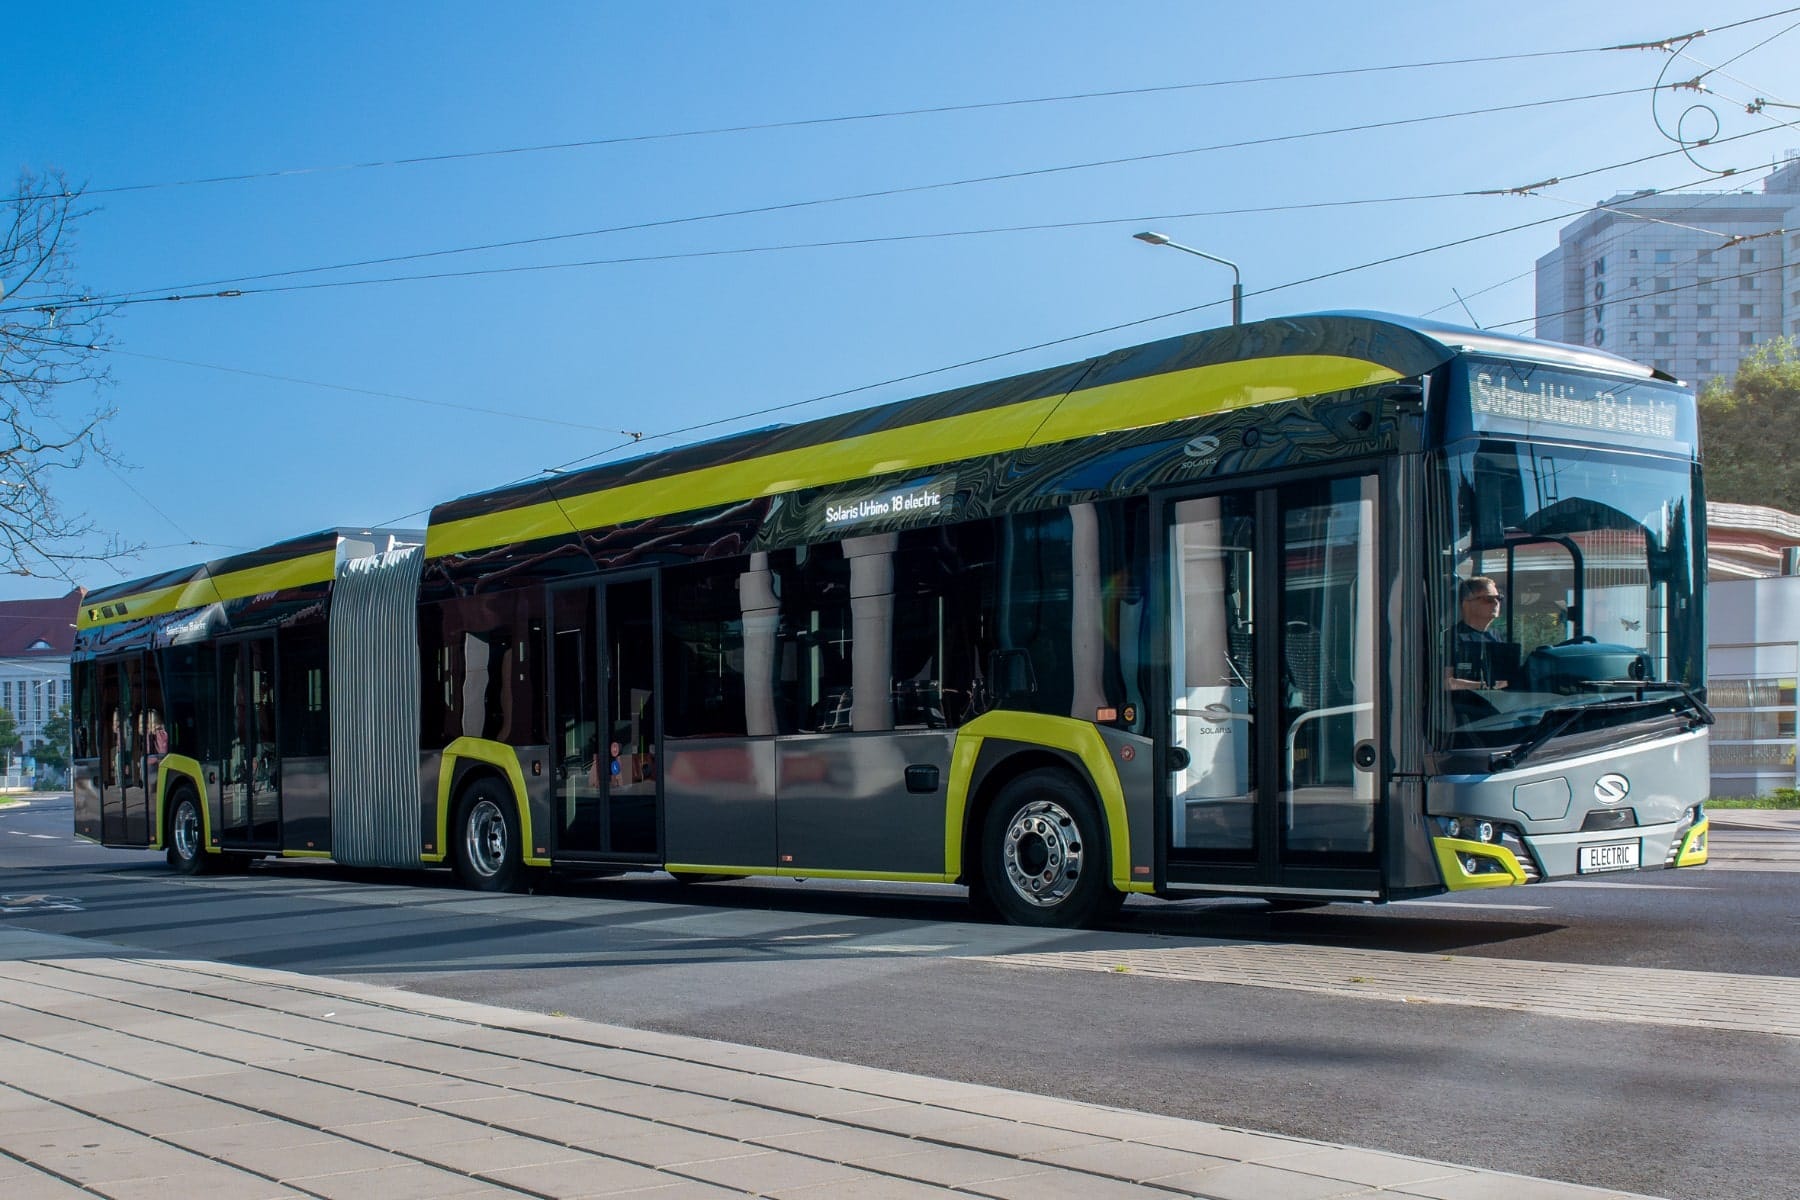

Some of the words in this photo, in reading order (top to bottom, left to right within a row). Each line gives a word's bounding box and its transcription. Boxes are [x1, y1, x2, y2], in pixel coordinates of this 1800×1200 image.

[1477, 373, 1539, 417] Solaris
[1541, 382, 1592, 425] Urbino
[1596, 391, 1616, 428] 18
[1618, 396, 1673, 437] electric
[826, 505, 858, 522] Solaris
[860, 500, 889, 517] Urbino
[892, 496, 903, 511] 18
[904, 490, 940, 510] electric
[1200, 727, 1232, 735] SOLARIS
[1591, 847, 1630, 867] ELECTRIC
